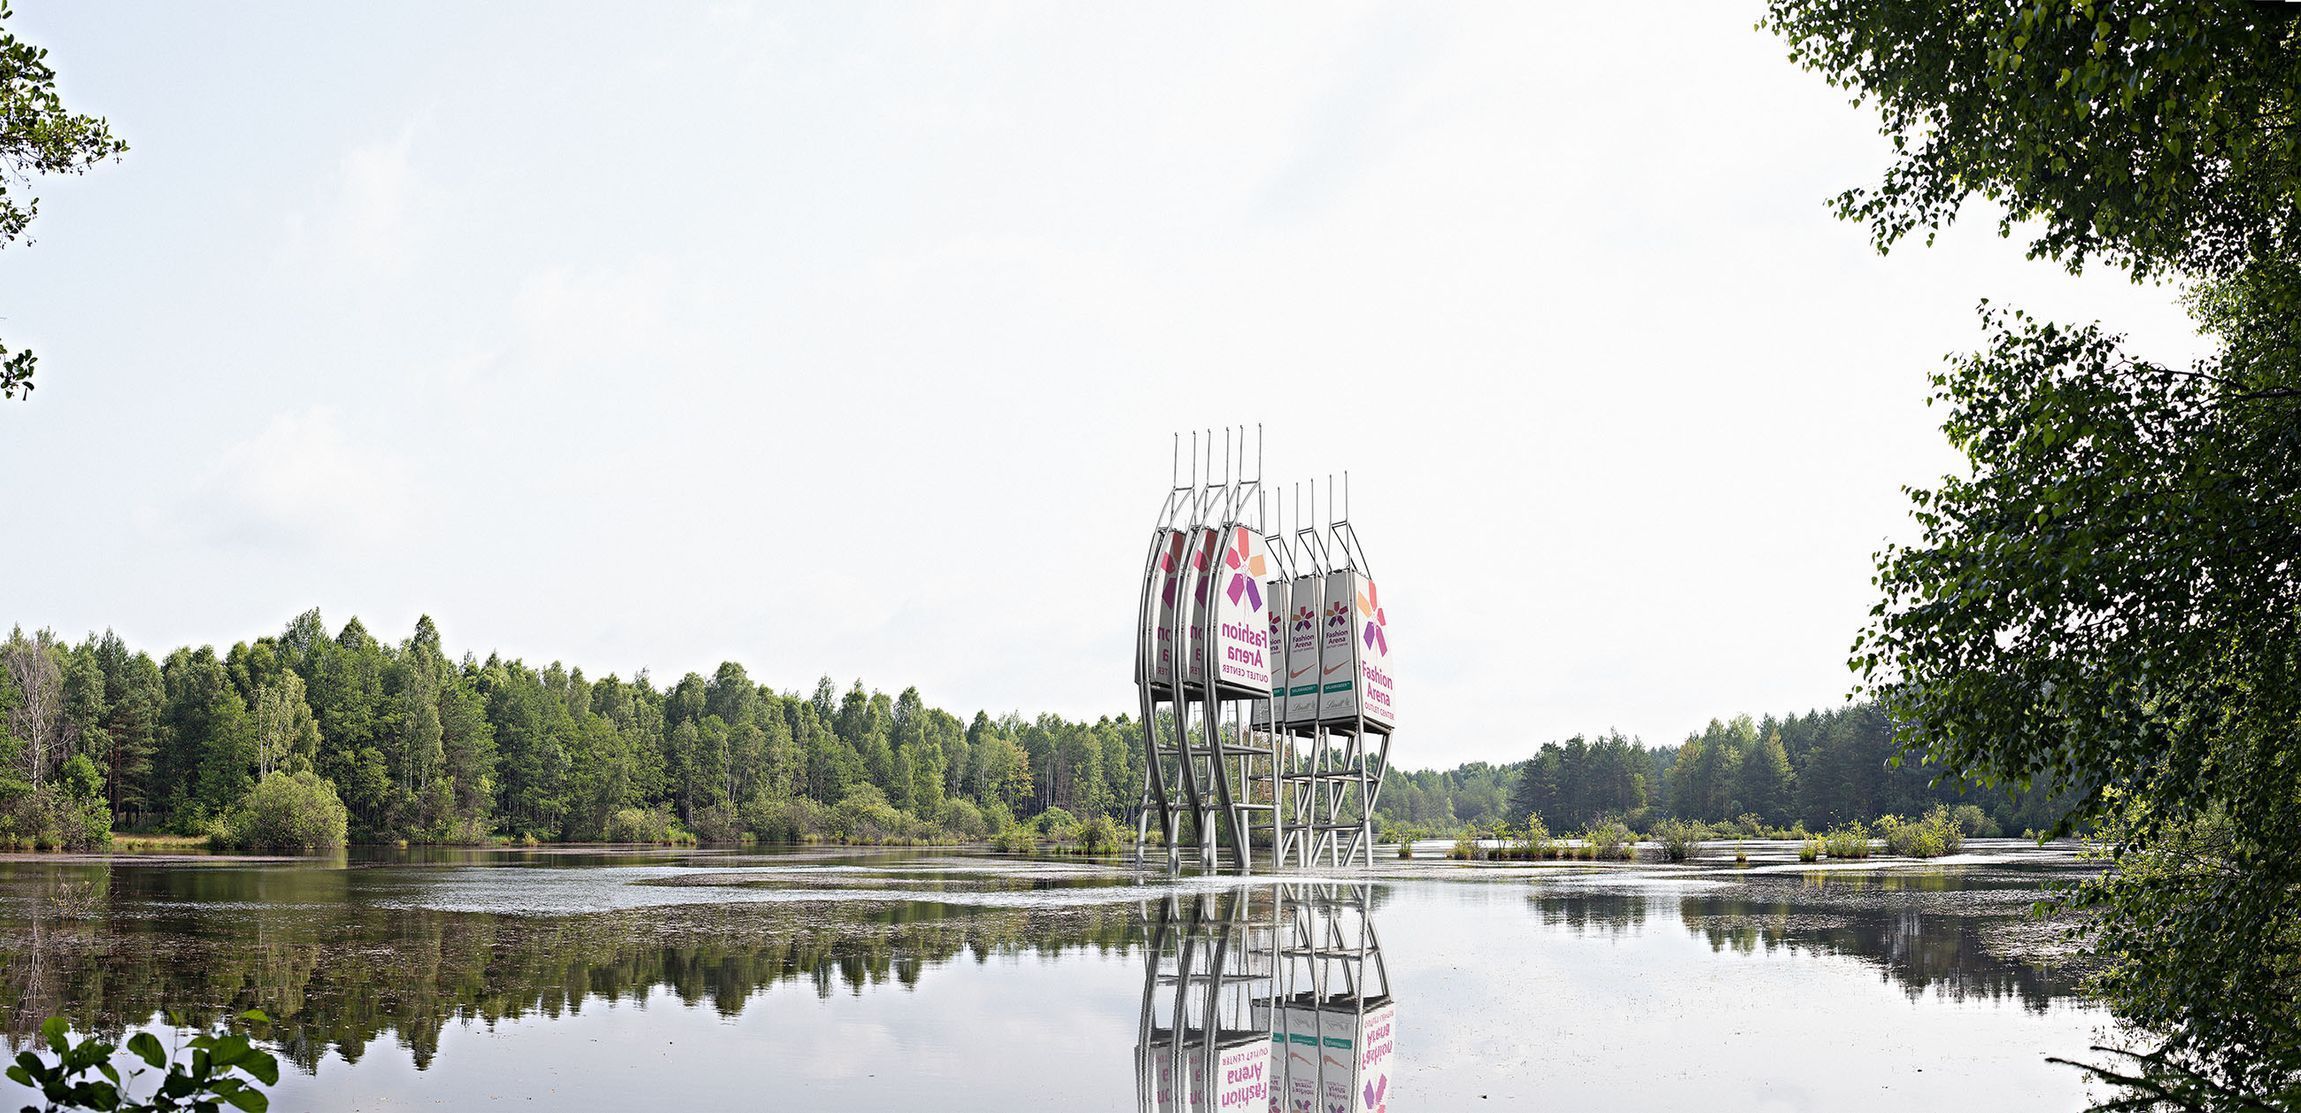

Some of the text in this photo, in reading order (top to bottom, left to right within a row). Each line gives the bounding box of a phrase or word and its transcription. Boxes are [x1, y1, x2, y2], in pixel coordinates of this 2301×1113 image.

[1292, 634, 1314, 643] Fashion
[1326, 630, 1348, 638] Fashion
[1328, 637, 1346, 645] Arena
[1362, 660, 1393, 690] Fashion
[1367, 682, 1391, 707] Arena
[1227, 1061, 1263, 1084] Arena
[1221, 1082, 1267, 1109] Fashion
